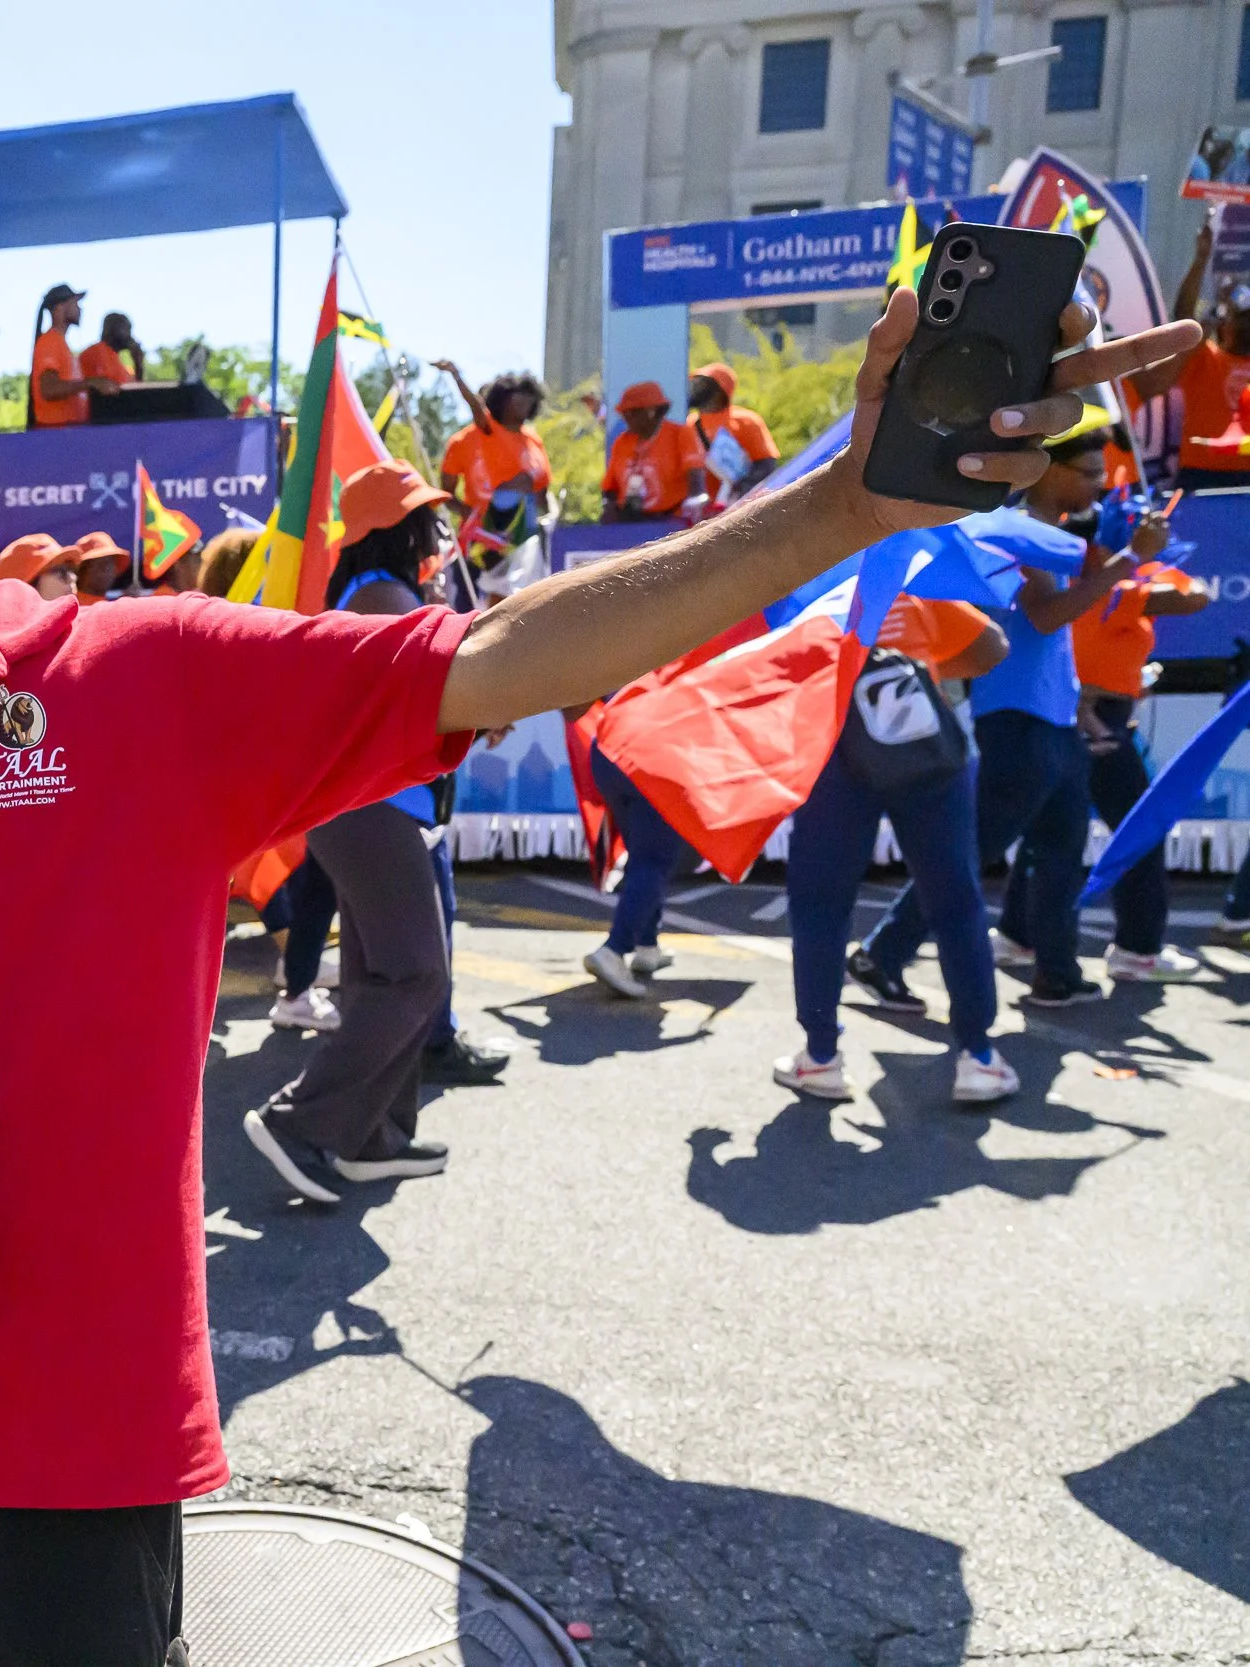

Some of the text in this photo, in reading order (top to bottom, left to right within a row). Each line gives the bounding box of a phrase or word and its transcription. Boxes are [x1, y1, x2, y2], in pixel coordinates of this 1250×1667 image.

[743, 232, 862, 264] Gotham
[4, 484, 88, 507] SECRET
[161, 478, 207, 498] THE
[213, 474, 268, 497] CITY
